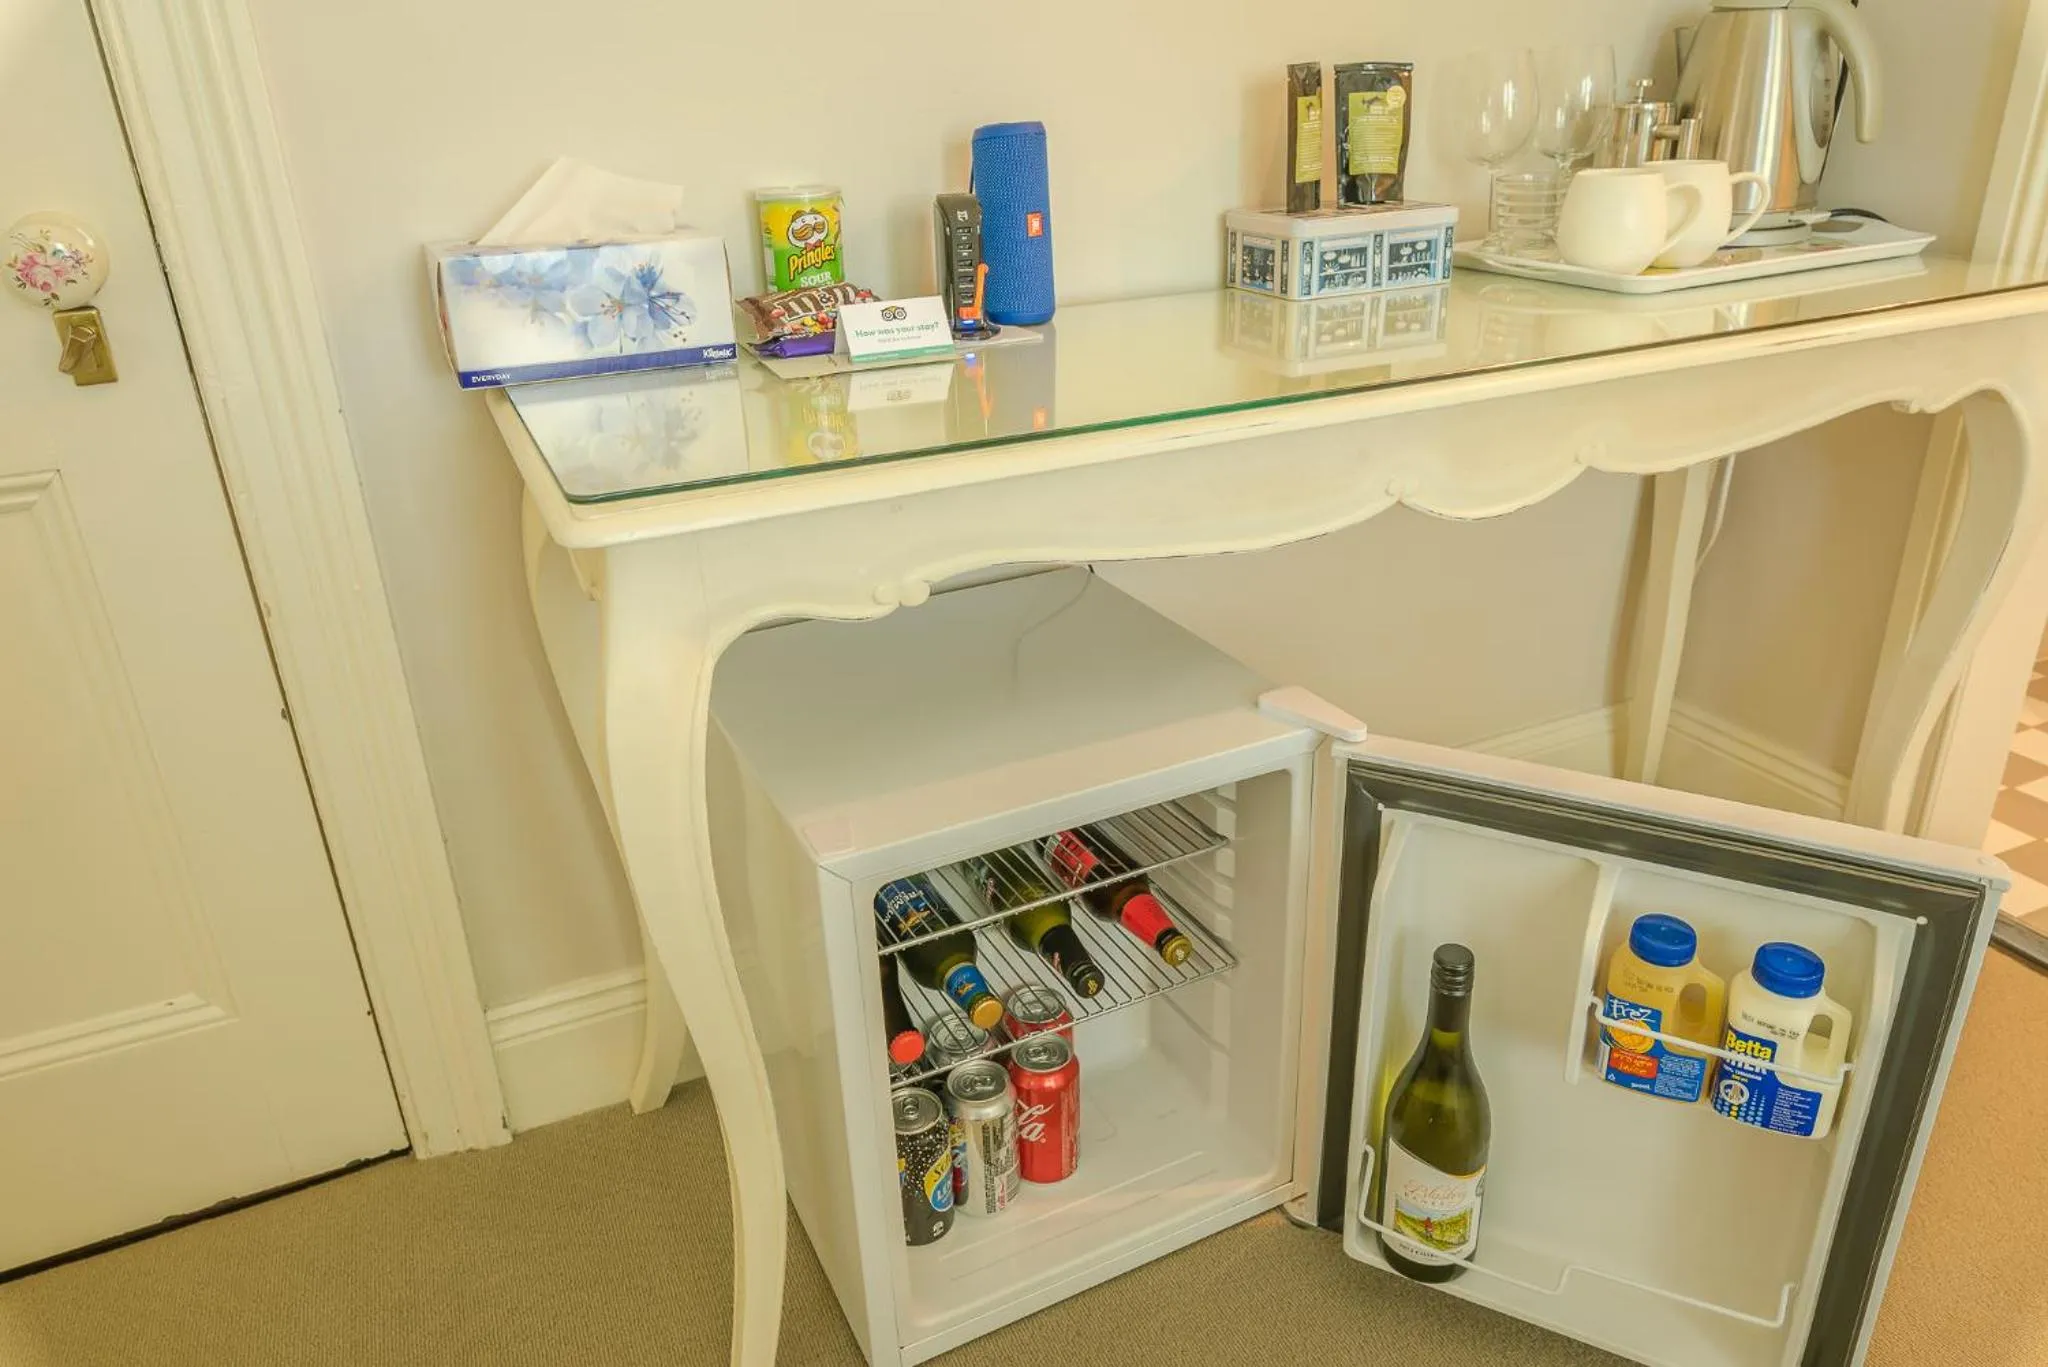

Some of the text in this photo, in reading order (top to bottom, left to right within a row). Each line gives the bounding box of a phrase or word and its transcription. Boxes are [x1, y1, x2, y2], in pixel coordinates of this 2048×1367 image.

[786, 243, 835, 281] Pringles
[800, 271, 832, 288] SOUR
[855, 329, 877, 338] How
[878, 328, 895, 336] was
[896, 325, 915, 338] your
[471, 373, 512, 383] EVERYDAY
[1725, 1029, 1772, 1061] Betta
